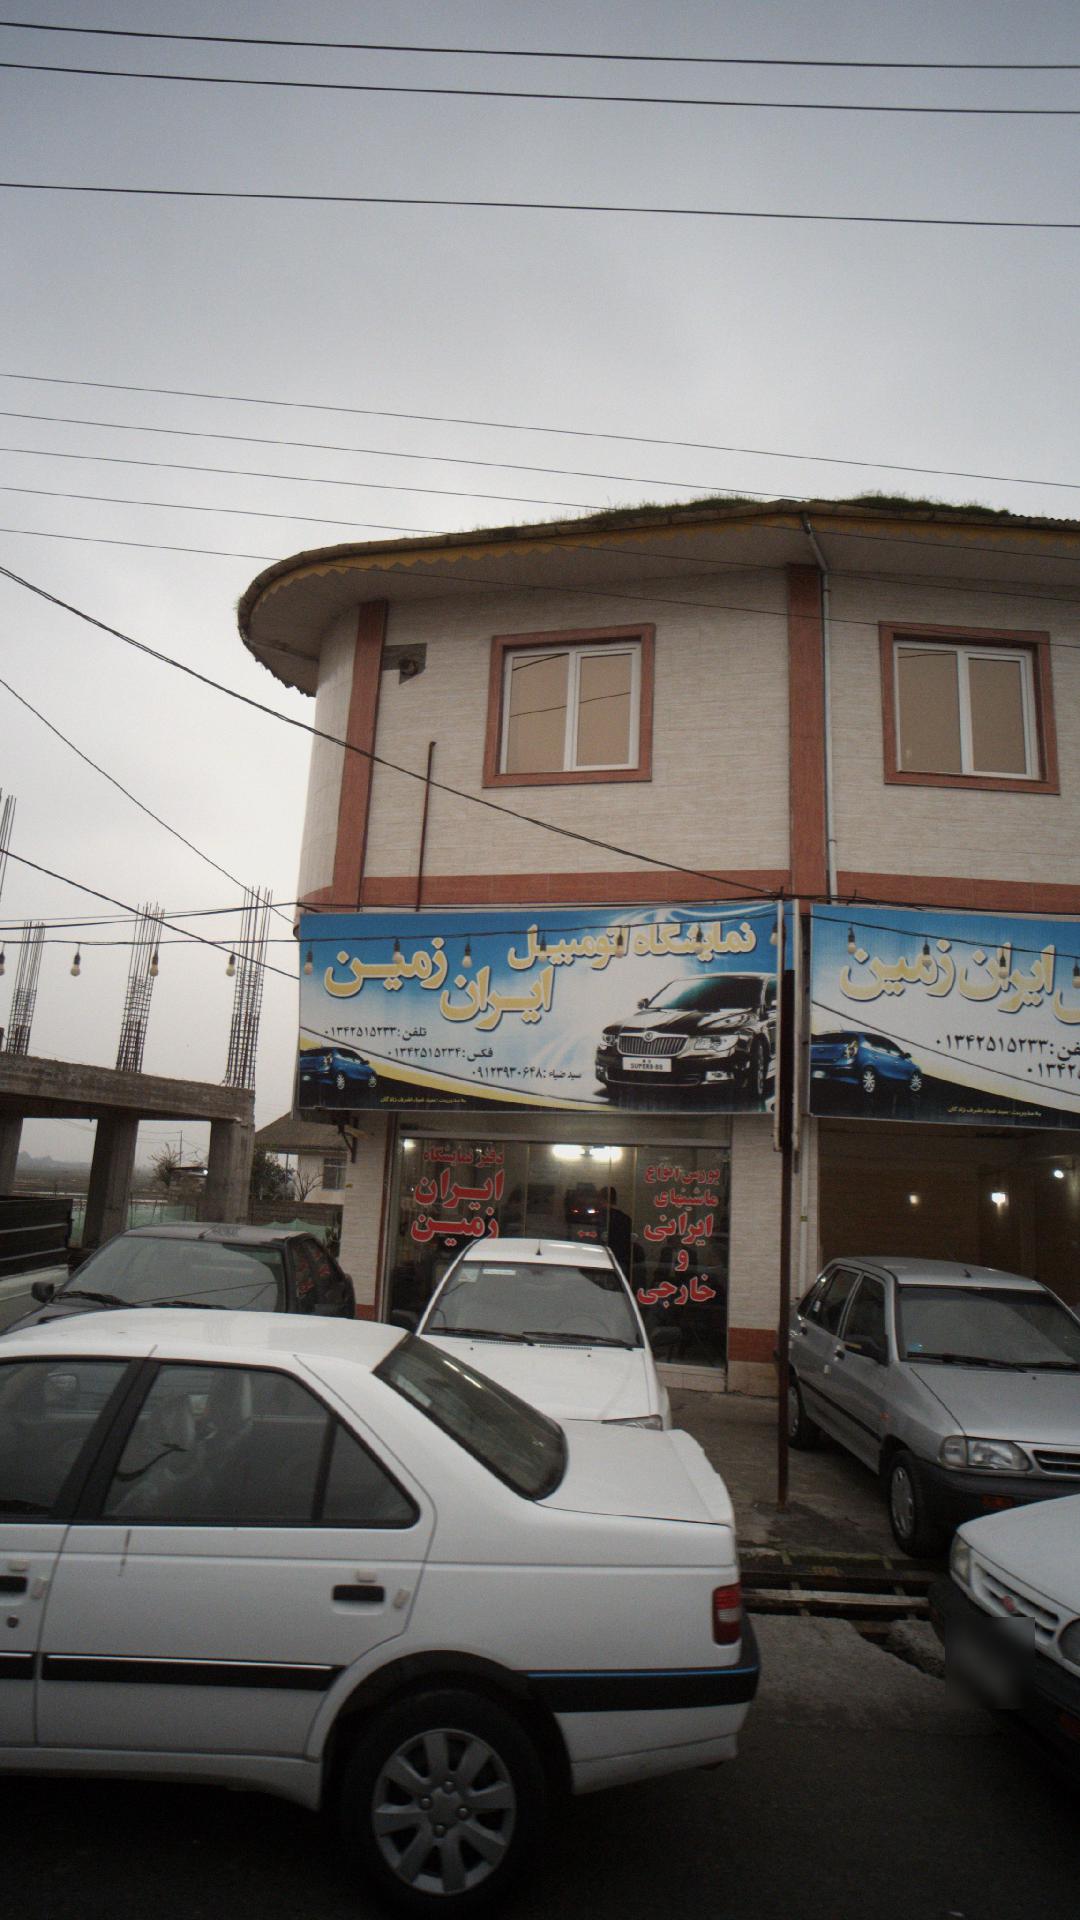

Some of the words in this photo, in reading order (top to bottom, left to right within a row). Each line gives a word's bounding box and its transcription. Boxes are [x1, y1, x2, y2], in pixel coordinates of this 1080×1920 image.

[507, 924, 633, 970] اتومبیل
[633, 920, 757, 962] نمایشگاه
[324, 937, 448, 998] زمین
[839, 939, 956, 1001] زمین
[958, 942, 1056, 1013] ایران
[440, 965, 555, 1031] ایران
[415, 1167, 504, 1210] ایران
[410, 1206, 499, 1247] زمین
[643, 1212, 714, 1246] ایرانی
[675, 1249, 689, 1272] و
[637, 1273, 717, 1308] خارجی
